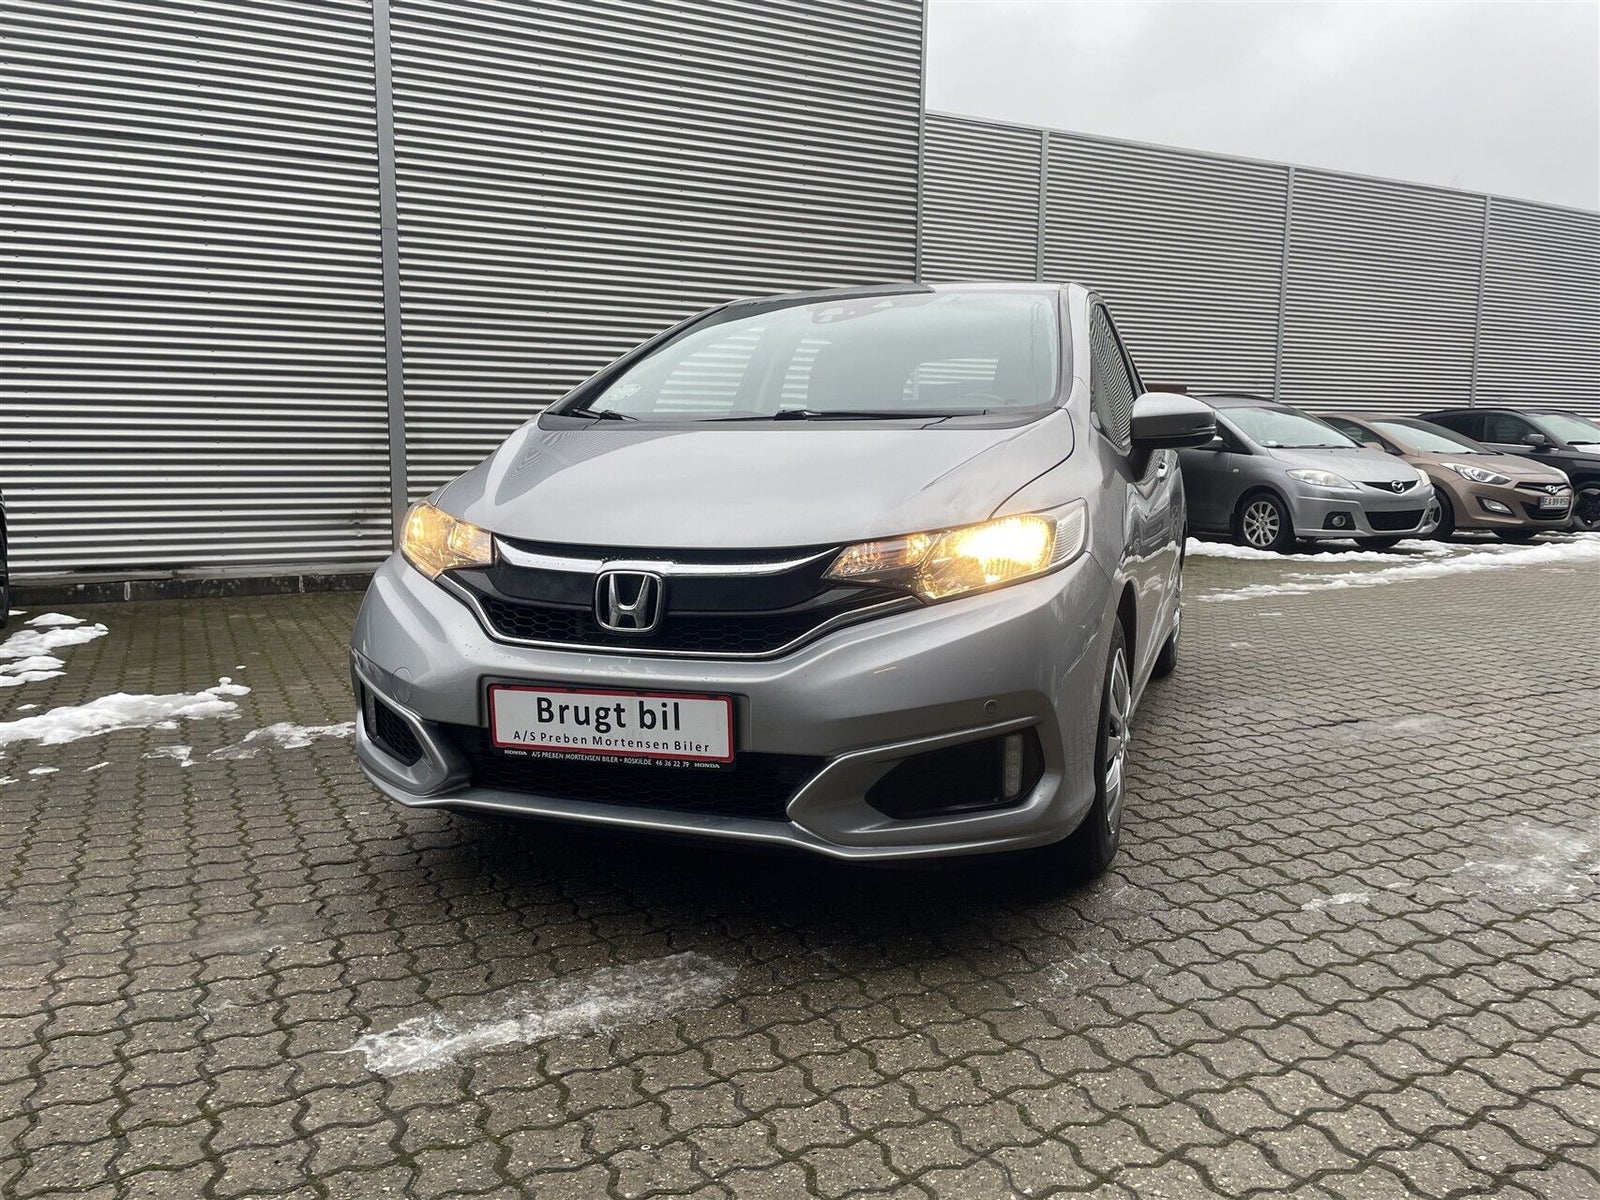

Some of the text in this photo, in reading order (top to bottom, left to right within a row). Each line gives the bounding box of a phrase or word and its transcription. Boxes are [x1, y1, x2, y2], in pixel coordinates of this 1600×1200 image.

[536, 697, 680, 733] Brugt bil
[513, 730, 710, 753] A/S Preben Mortensen Biler
[565, 753, 601, 761] MORTENSEN
[624, 757, 652, 765] ROSKILDE
